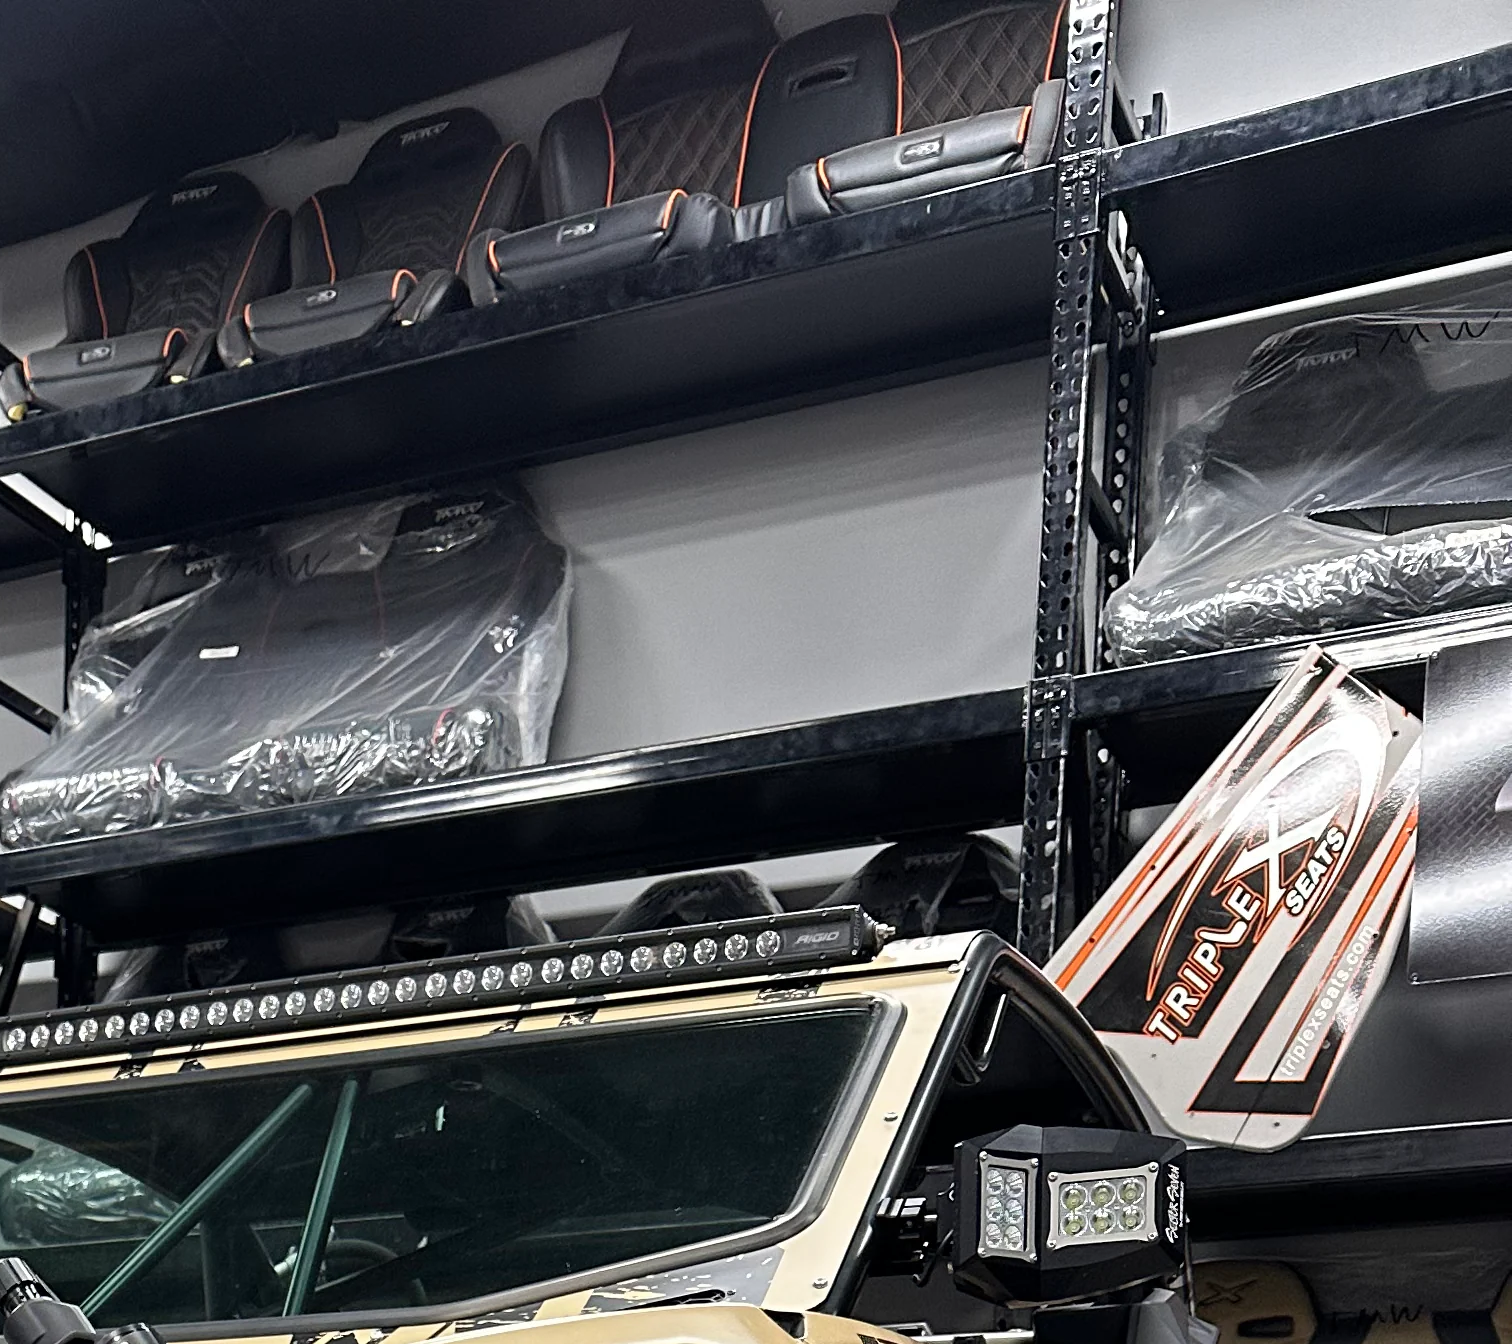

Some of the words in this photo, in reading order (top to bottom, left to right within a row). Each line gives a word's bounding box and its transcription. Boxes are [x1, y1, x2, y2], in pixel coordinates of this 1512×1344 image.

[1285, 826, 1347, 915] SEATS
[795, 931, 840, 945] RIGID
[1146, 884, 1263, 1043] TRIPLE
[1280, 924, 1376, 1077] triplexseats.com
